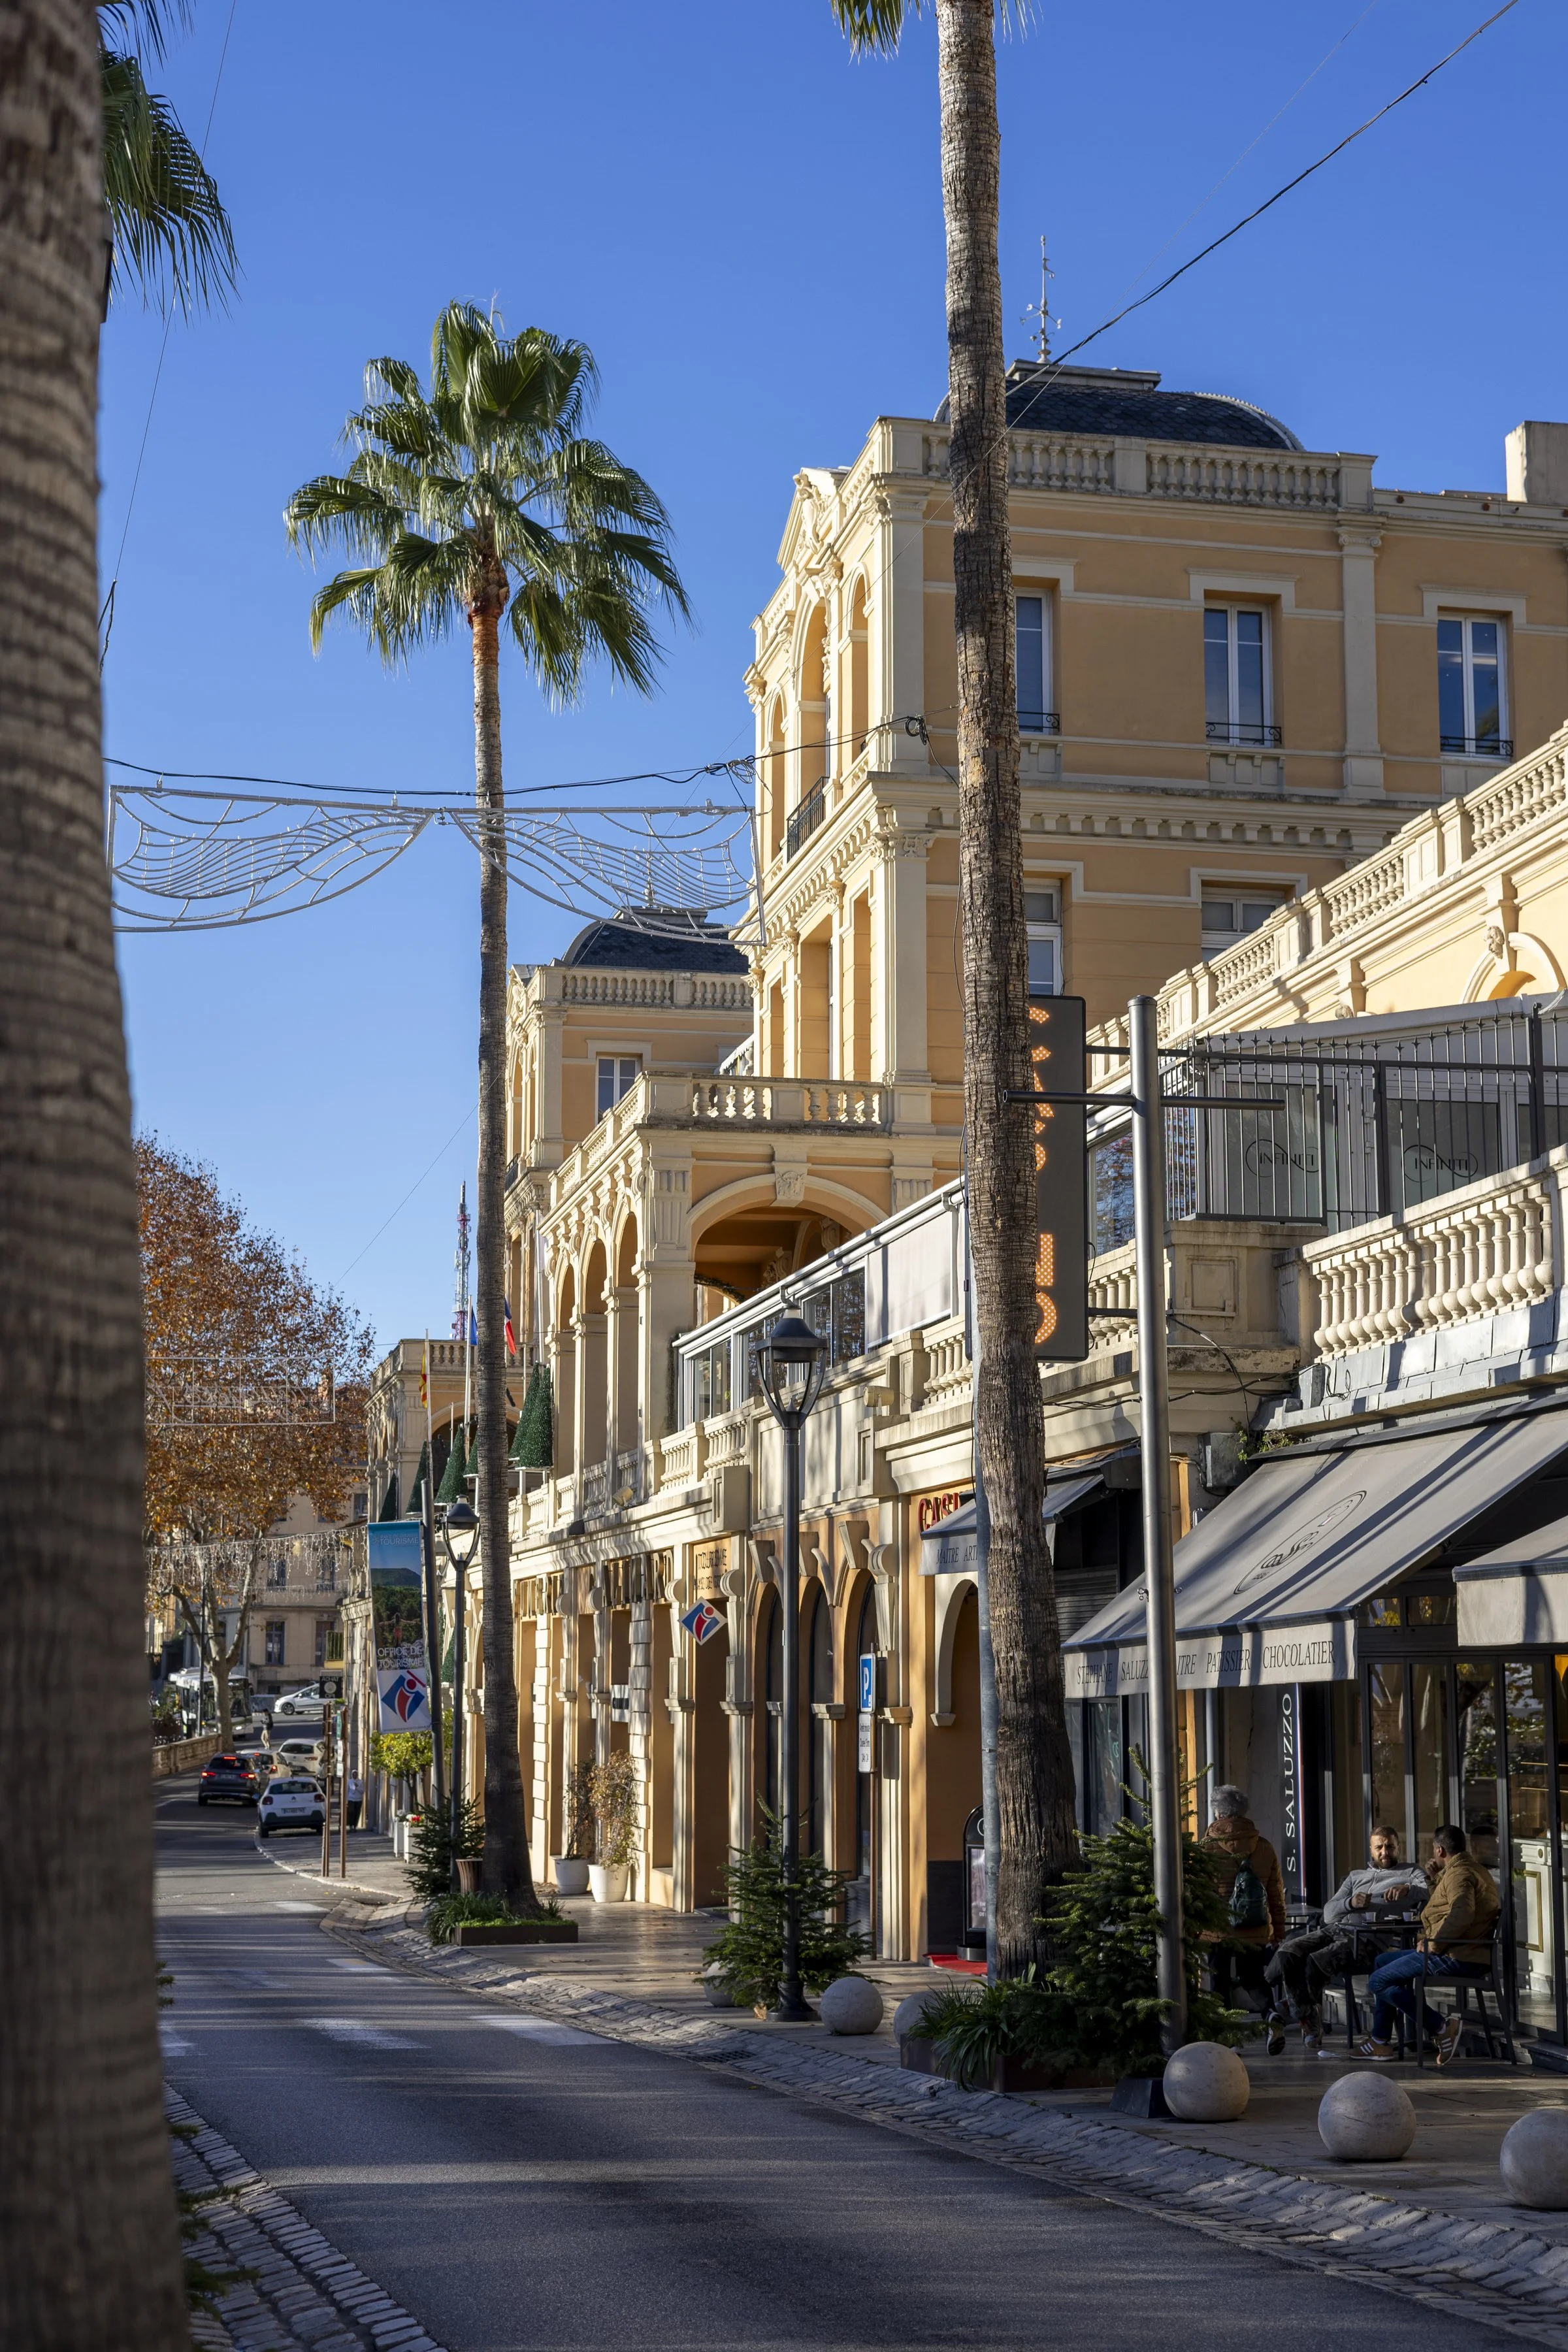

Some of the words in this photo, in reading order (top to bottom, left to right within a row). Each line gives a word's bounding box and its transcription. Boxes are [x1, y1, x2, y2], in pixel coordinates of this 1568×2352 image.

[1415, 1157, 1468, 1171] INFINITI
[936, 1547, 959, 1564] MAITRE
[964, 1545, 978, 1561] ARTI
[378, 1646, 408, 1657] OFFICE
[410, 1646, 423, 1655] DE
[378, 1658, 423, 1668] TOURISME
[1077, 1662, 1113, 1685] STEPHANE
[1121, 1659, 1149, 1681] SALUZZ
[1176, 1654, 1197, 1676] ITRE
[1206, 1648, 1250, 1673] PATISSIER
[1263, 1640, 1335, 1669] CHOCOLATIER
[864, 1667, 870, 1700] P
[1282, 1693, 1296, 1838] SALUZZO
[1287, 1844, 1296, 1872] S.
